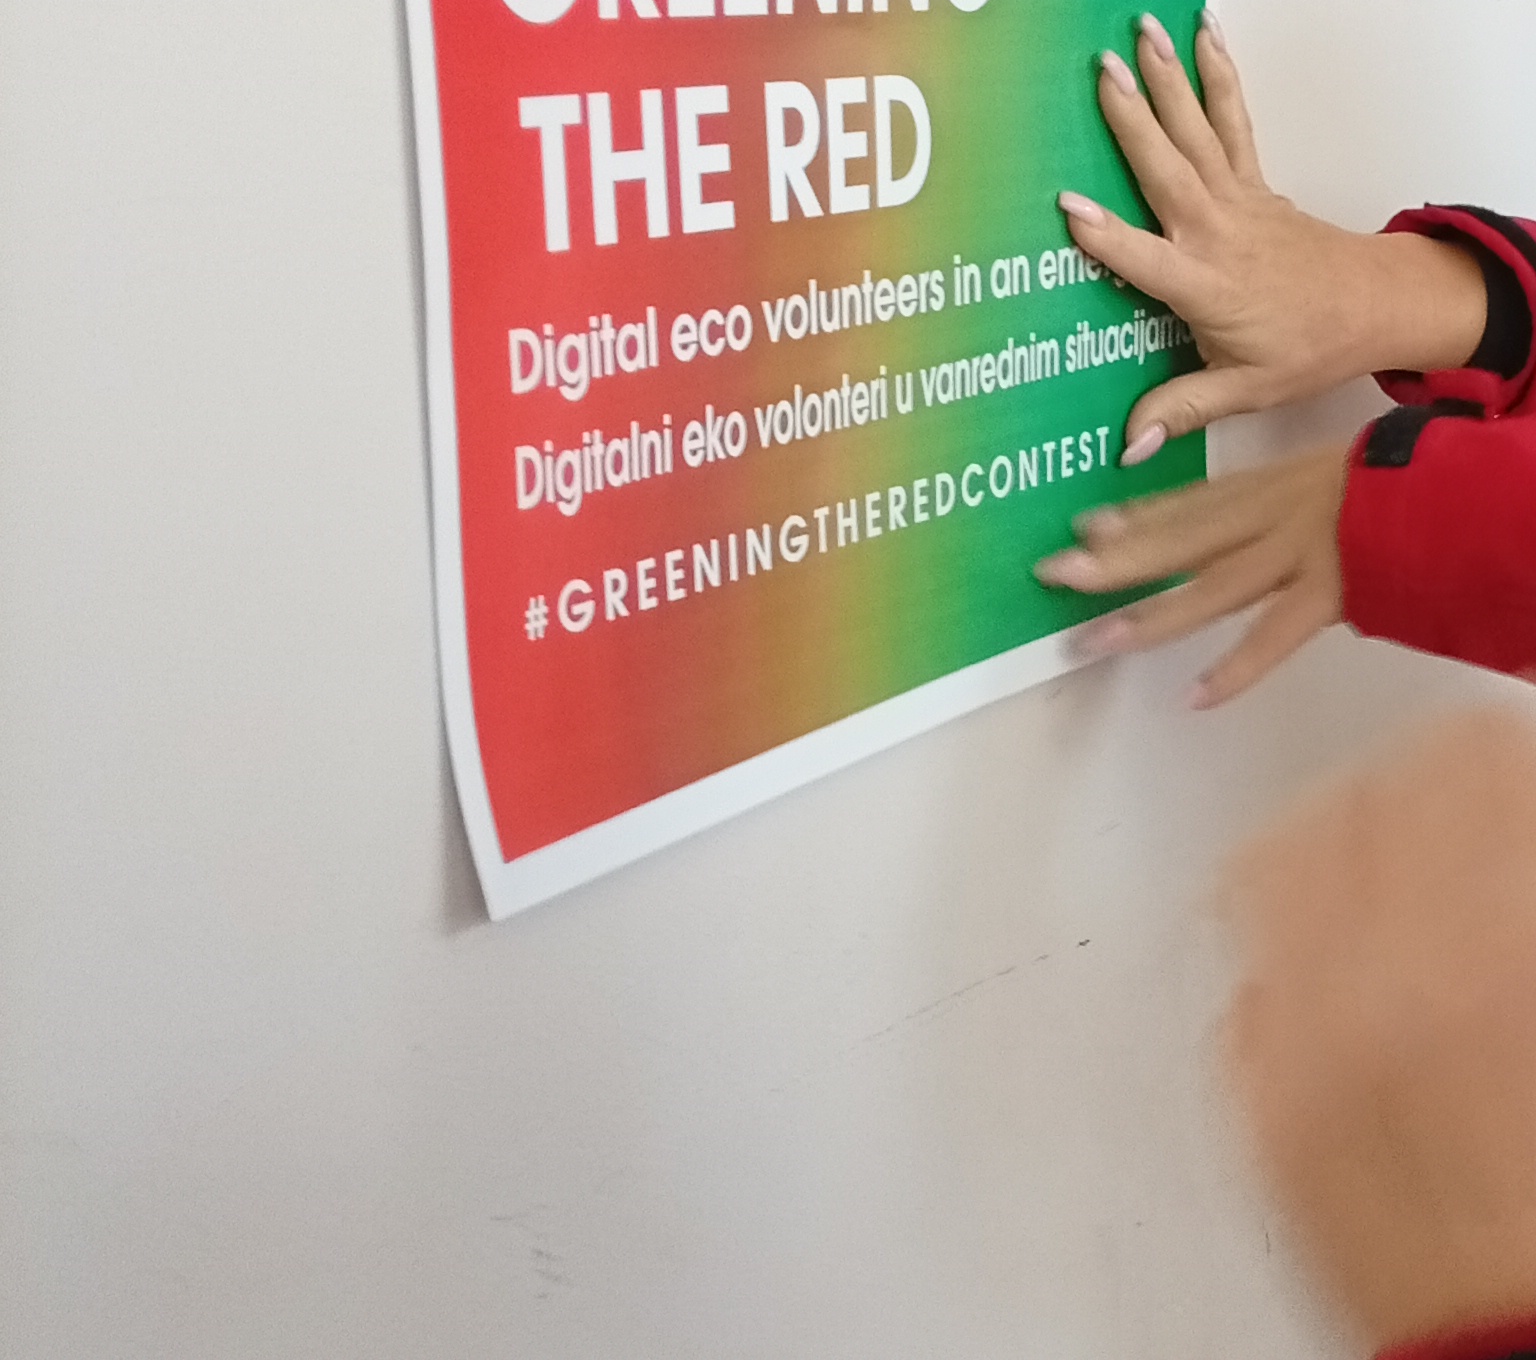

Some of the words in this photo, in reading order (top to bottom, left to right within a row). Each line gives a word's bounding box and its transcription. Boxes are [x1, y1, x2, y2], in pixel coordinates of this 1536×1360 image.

[518, 84, 736, 253] THE
[764, 74, 932, 223] RED
[507, 305, 660, 402] Digital
[670, 303, 753, 363] eco
[761, 269, 946, 343] volunteers
[953, 253, 982, 307] in
[990, 254, 1031, 300] an
[514, 413, 673, 517] Digitalni
[682, 403, 748, 468] eko
[754, 365, 888, 449] volonteri
[895, 371, 914, 415] u
[919, 332, 1061, 408] vanrednim
[524, 425, 1110, 641] #GREENINGTHEREDCONTEST
